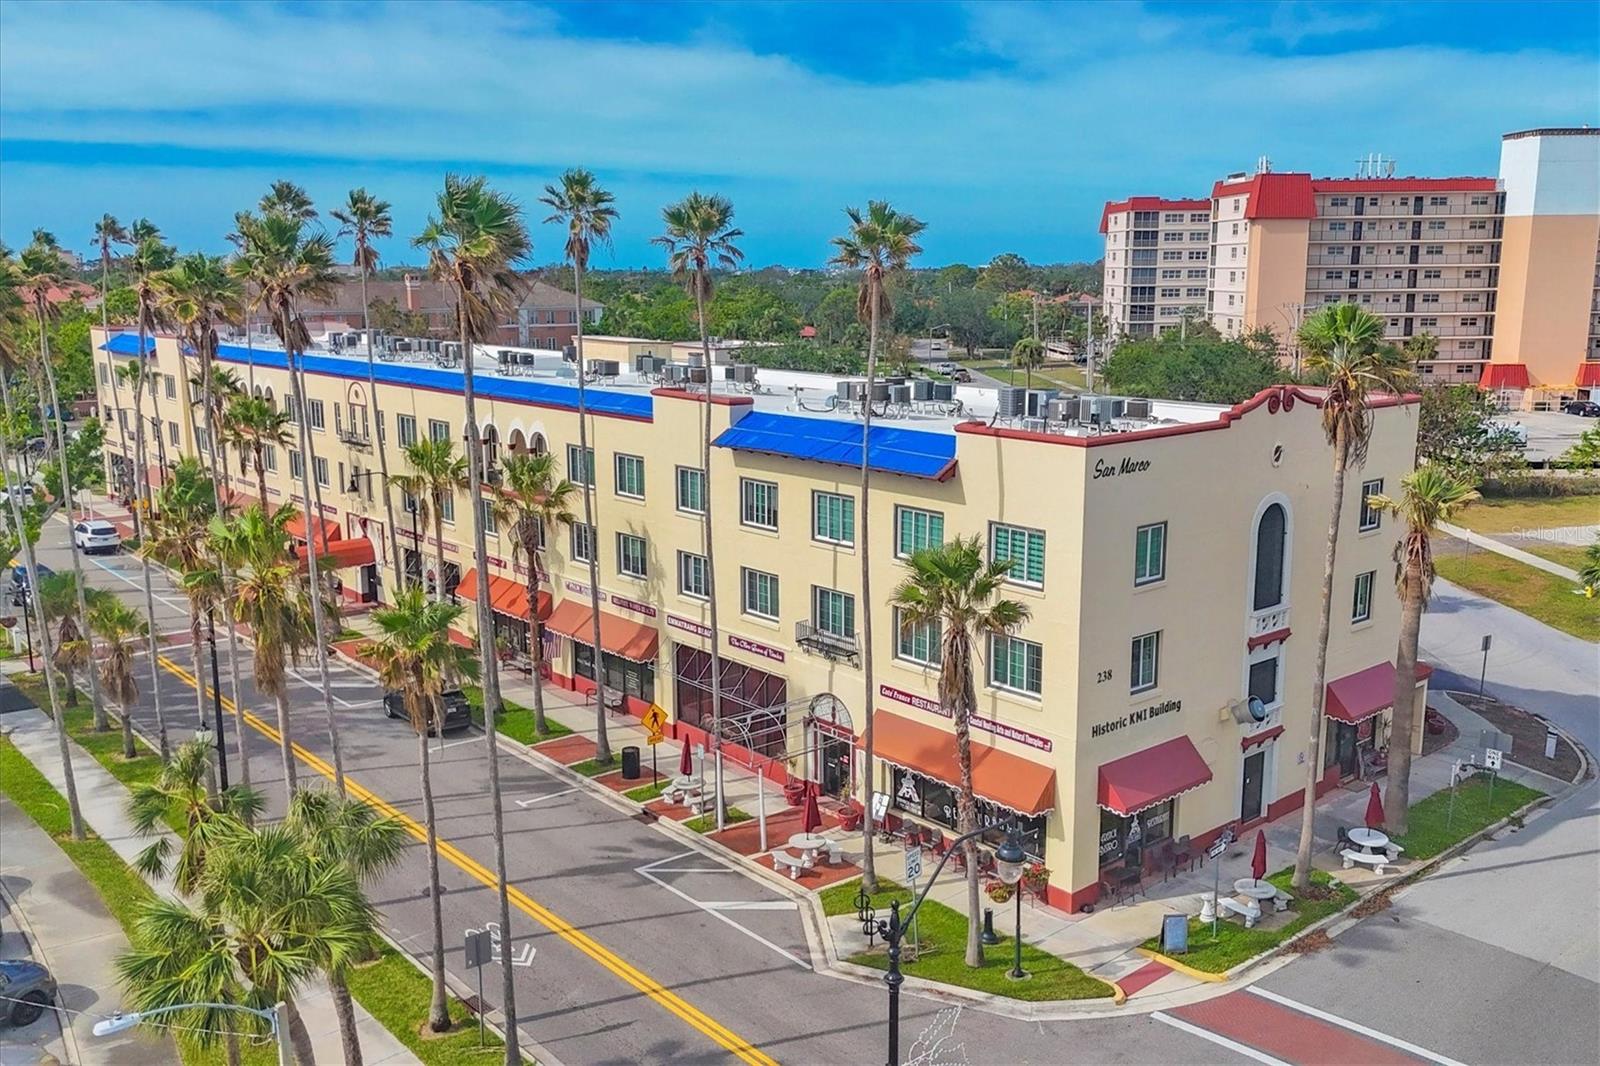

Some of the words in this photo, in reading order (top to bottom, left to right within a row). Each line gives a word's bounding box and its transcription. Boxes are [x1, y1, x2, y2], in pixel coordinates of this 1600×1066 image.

[1093, 458, 1115, 479] San
[1117, 456, 1151, 476] Marco
[1097, 669, 1113, 684] 238
[1091, 716, 1128, 738] Historic
[1129, 708, 1147, 725] KMI
[1149, 699, 1182, 719] Building
[907, 862, 921, 879] 20
